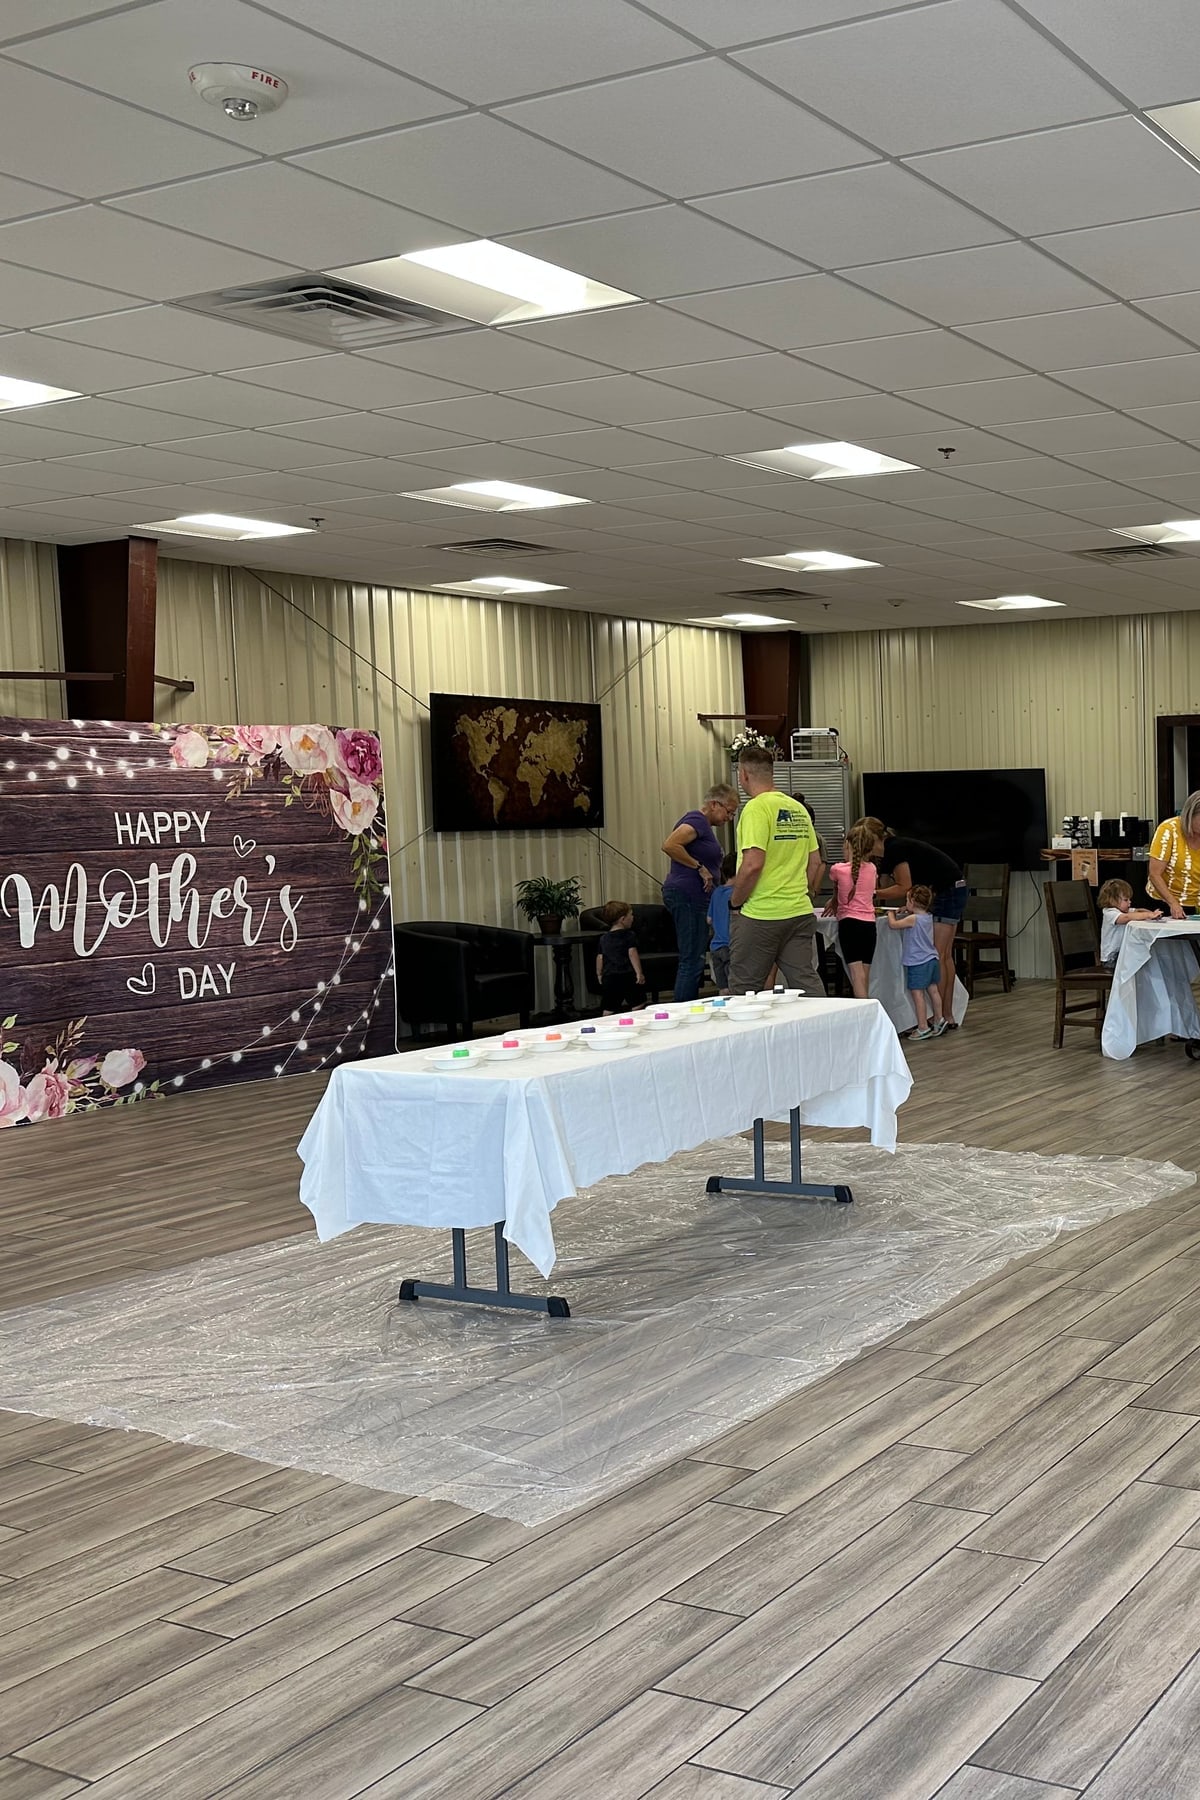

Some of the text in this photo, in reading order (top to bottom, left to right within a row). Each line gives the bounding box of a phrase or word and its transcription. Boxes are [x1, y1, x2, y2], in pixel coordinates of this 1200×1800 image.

[251, 71, 279, 88] FIRE
[115, 811, 211, 845] HAPPY
[1, 852, 304, 957] Mother's
[178, 962, 236, 1000] DAY
